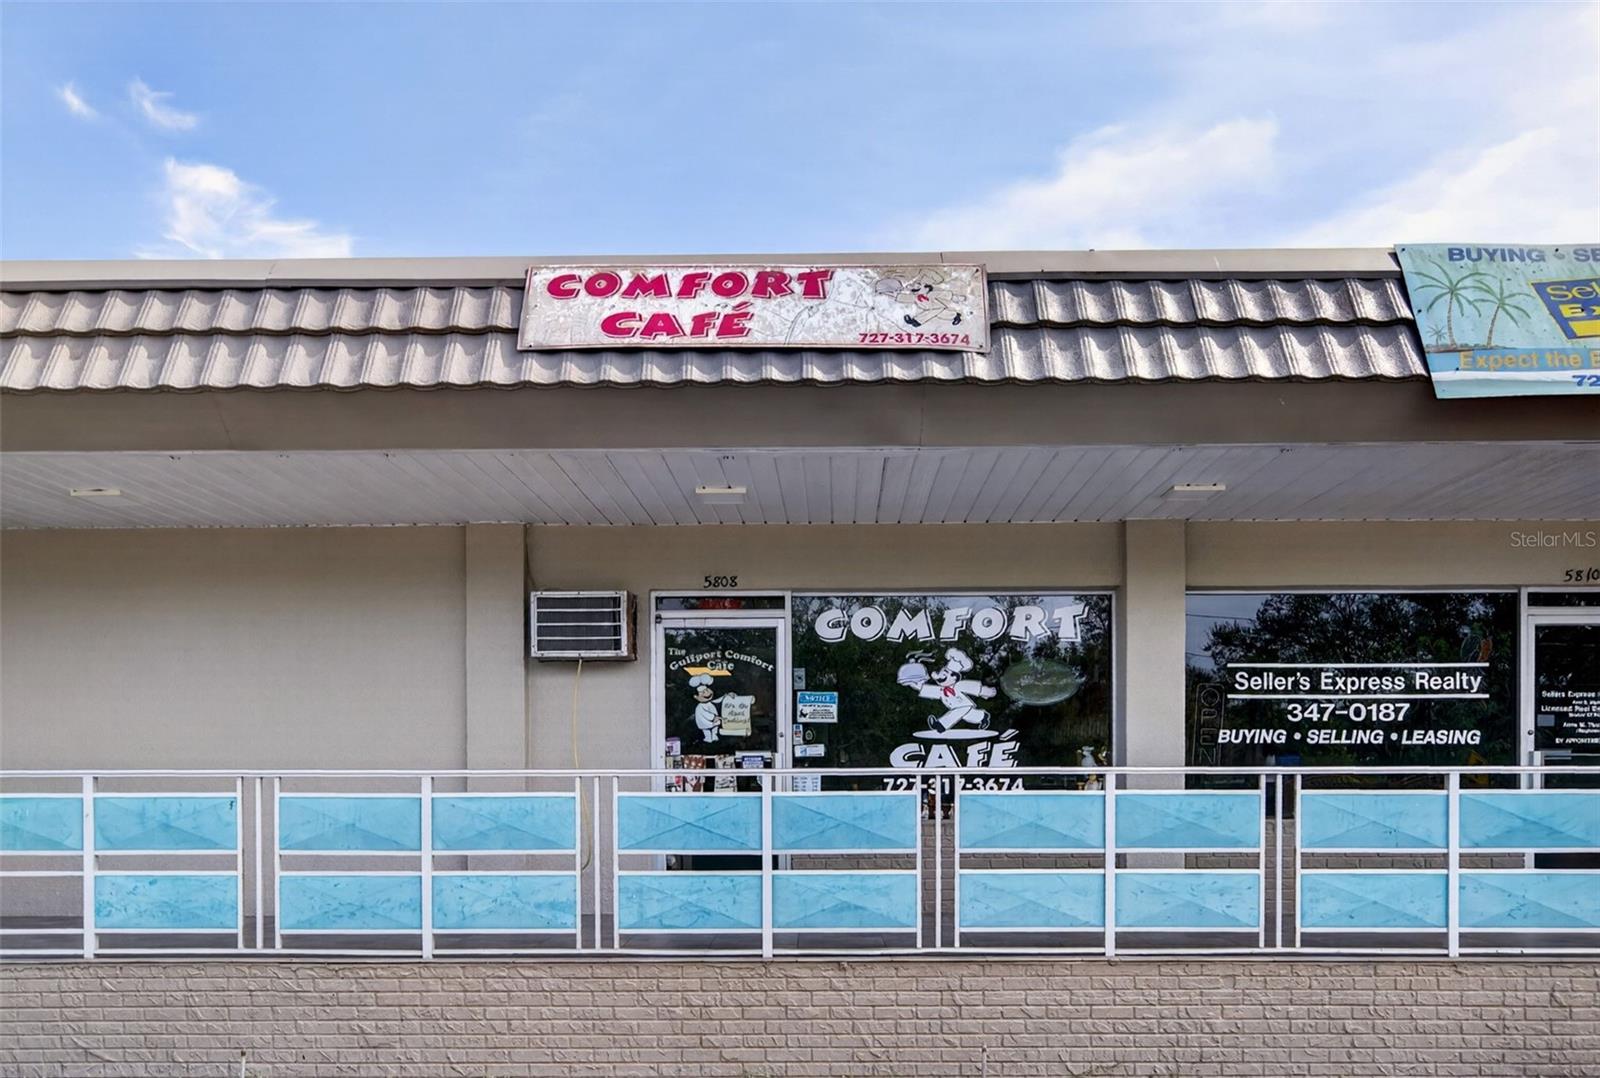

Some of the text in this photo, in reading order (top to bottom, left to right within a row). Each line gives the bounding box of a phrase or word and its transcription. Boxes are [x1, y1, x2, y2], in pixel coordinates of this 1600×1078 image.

[1448, 247, 1546, 263] BUYING
[547, 268, 834, 300] COMFORT
[600, 302, 754, 340] CAFÉ
[859, 332, 971, 346] 727-317-3674
[1460, 351, 1538, 371] Expect
[1545, 351, 1582, 368] the
[703, 575, 738, 589] 5808
[1563, 567, 1600, 582] 5810
[814, 605, 1089, 642] COMFORT
[669, 650, 775, 672] Gulfport Comfort
[1234, 671, 1482, 693] Seller's Express Realty
[1287, 702, 1410, 722] 347-0187
[1217, 728, 1481, 745] BUYING SELLING LEASING
[889, 729, 1020, 768] CAFÉ
